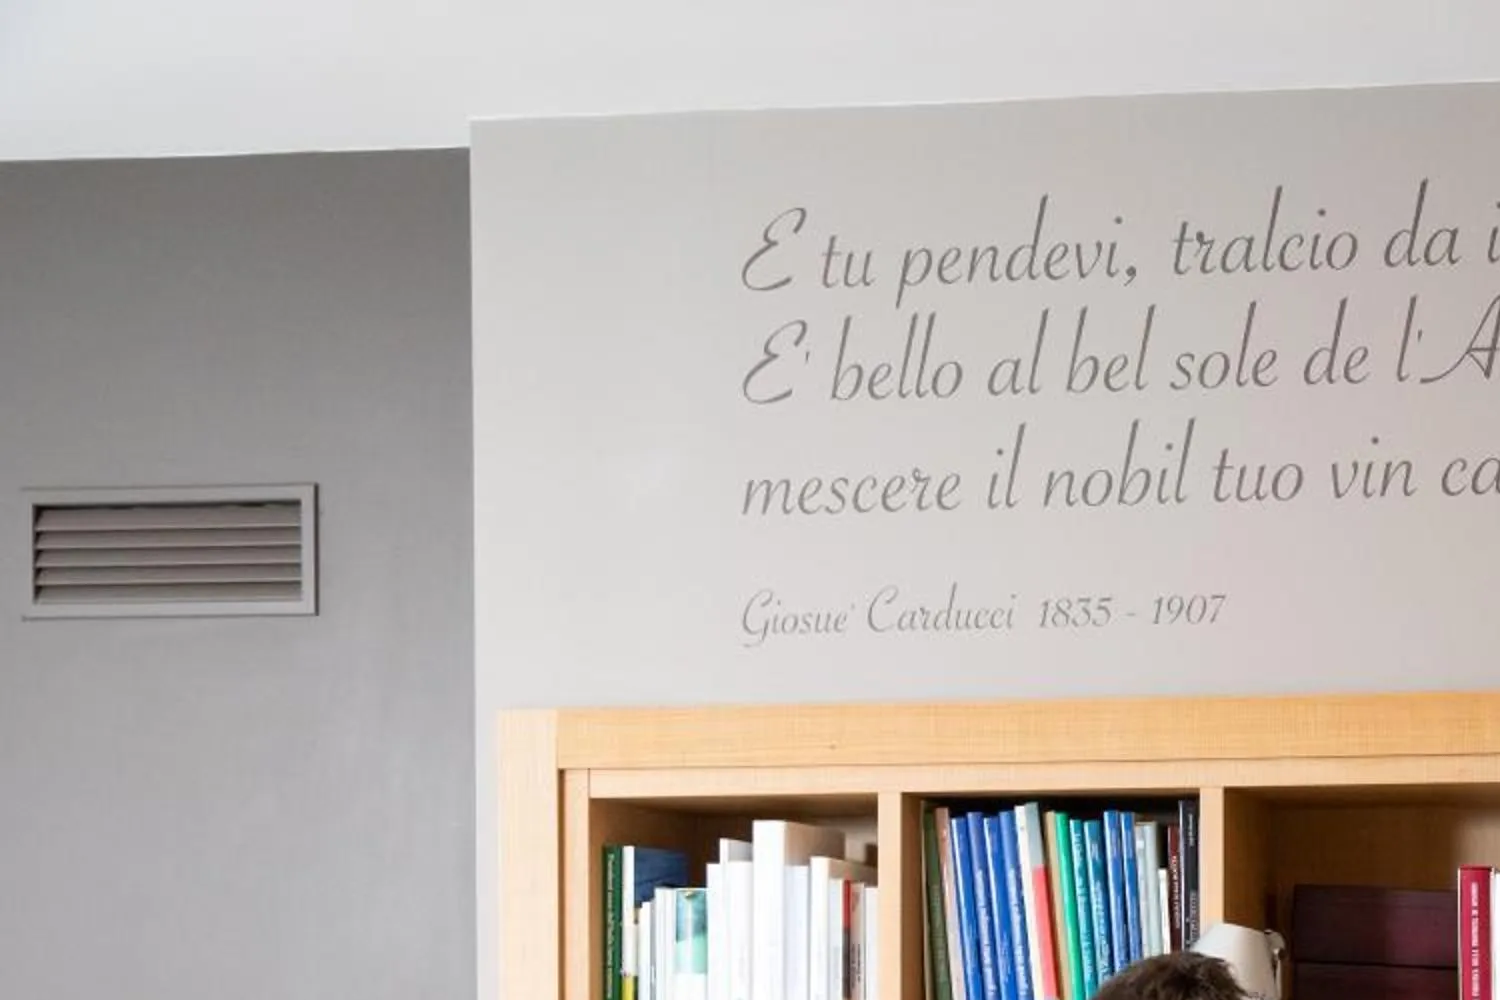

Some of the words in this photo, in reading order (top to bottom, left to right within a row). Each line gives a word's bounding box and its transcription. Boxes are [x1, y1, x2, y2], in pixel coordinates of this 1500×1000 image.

[742, 208, 807, 291] E
[820, 233, 876, 290] tu
[896, 194, 1136, 309] pendevi,
[1174, 185, 1358, 275] tralcio
[1384, 177, 1461, 268] da
[831, 312, 963, 400] bello
[988, 308, 1049, 396] al
[1066, 304, 1156, 393] bel
[1170, 300, 1278, 390] sole
[1304, 297, 1369, 385] de
[742, 468, 960, 515] mescere
[988, 422, 1026, 509] il
[1044, 417, 1196, 507] nobil
[1213, 448, 1304, 502] tuo
[1332, 437, 1417, 499] vin
[868, 583, 1016, 632] Carducci
[1040, 597, 1112, 627] 1835
[1153, 595, 1226, 624] 1907
